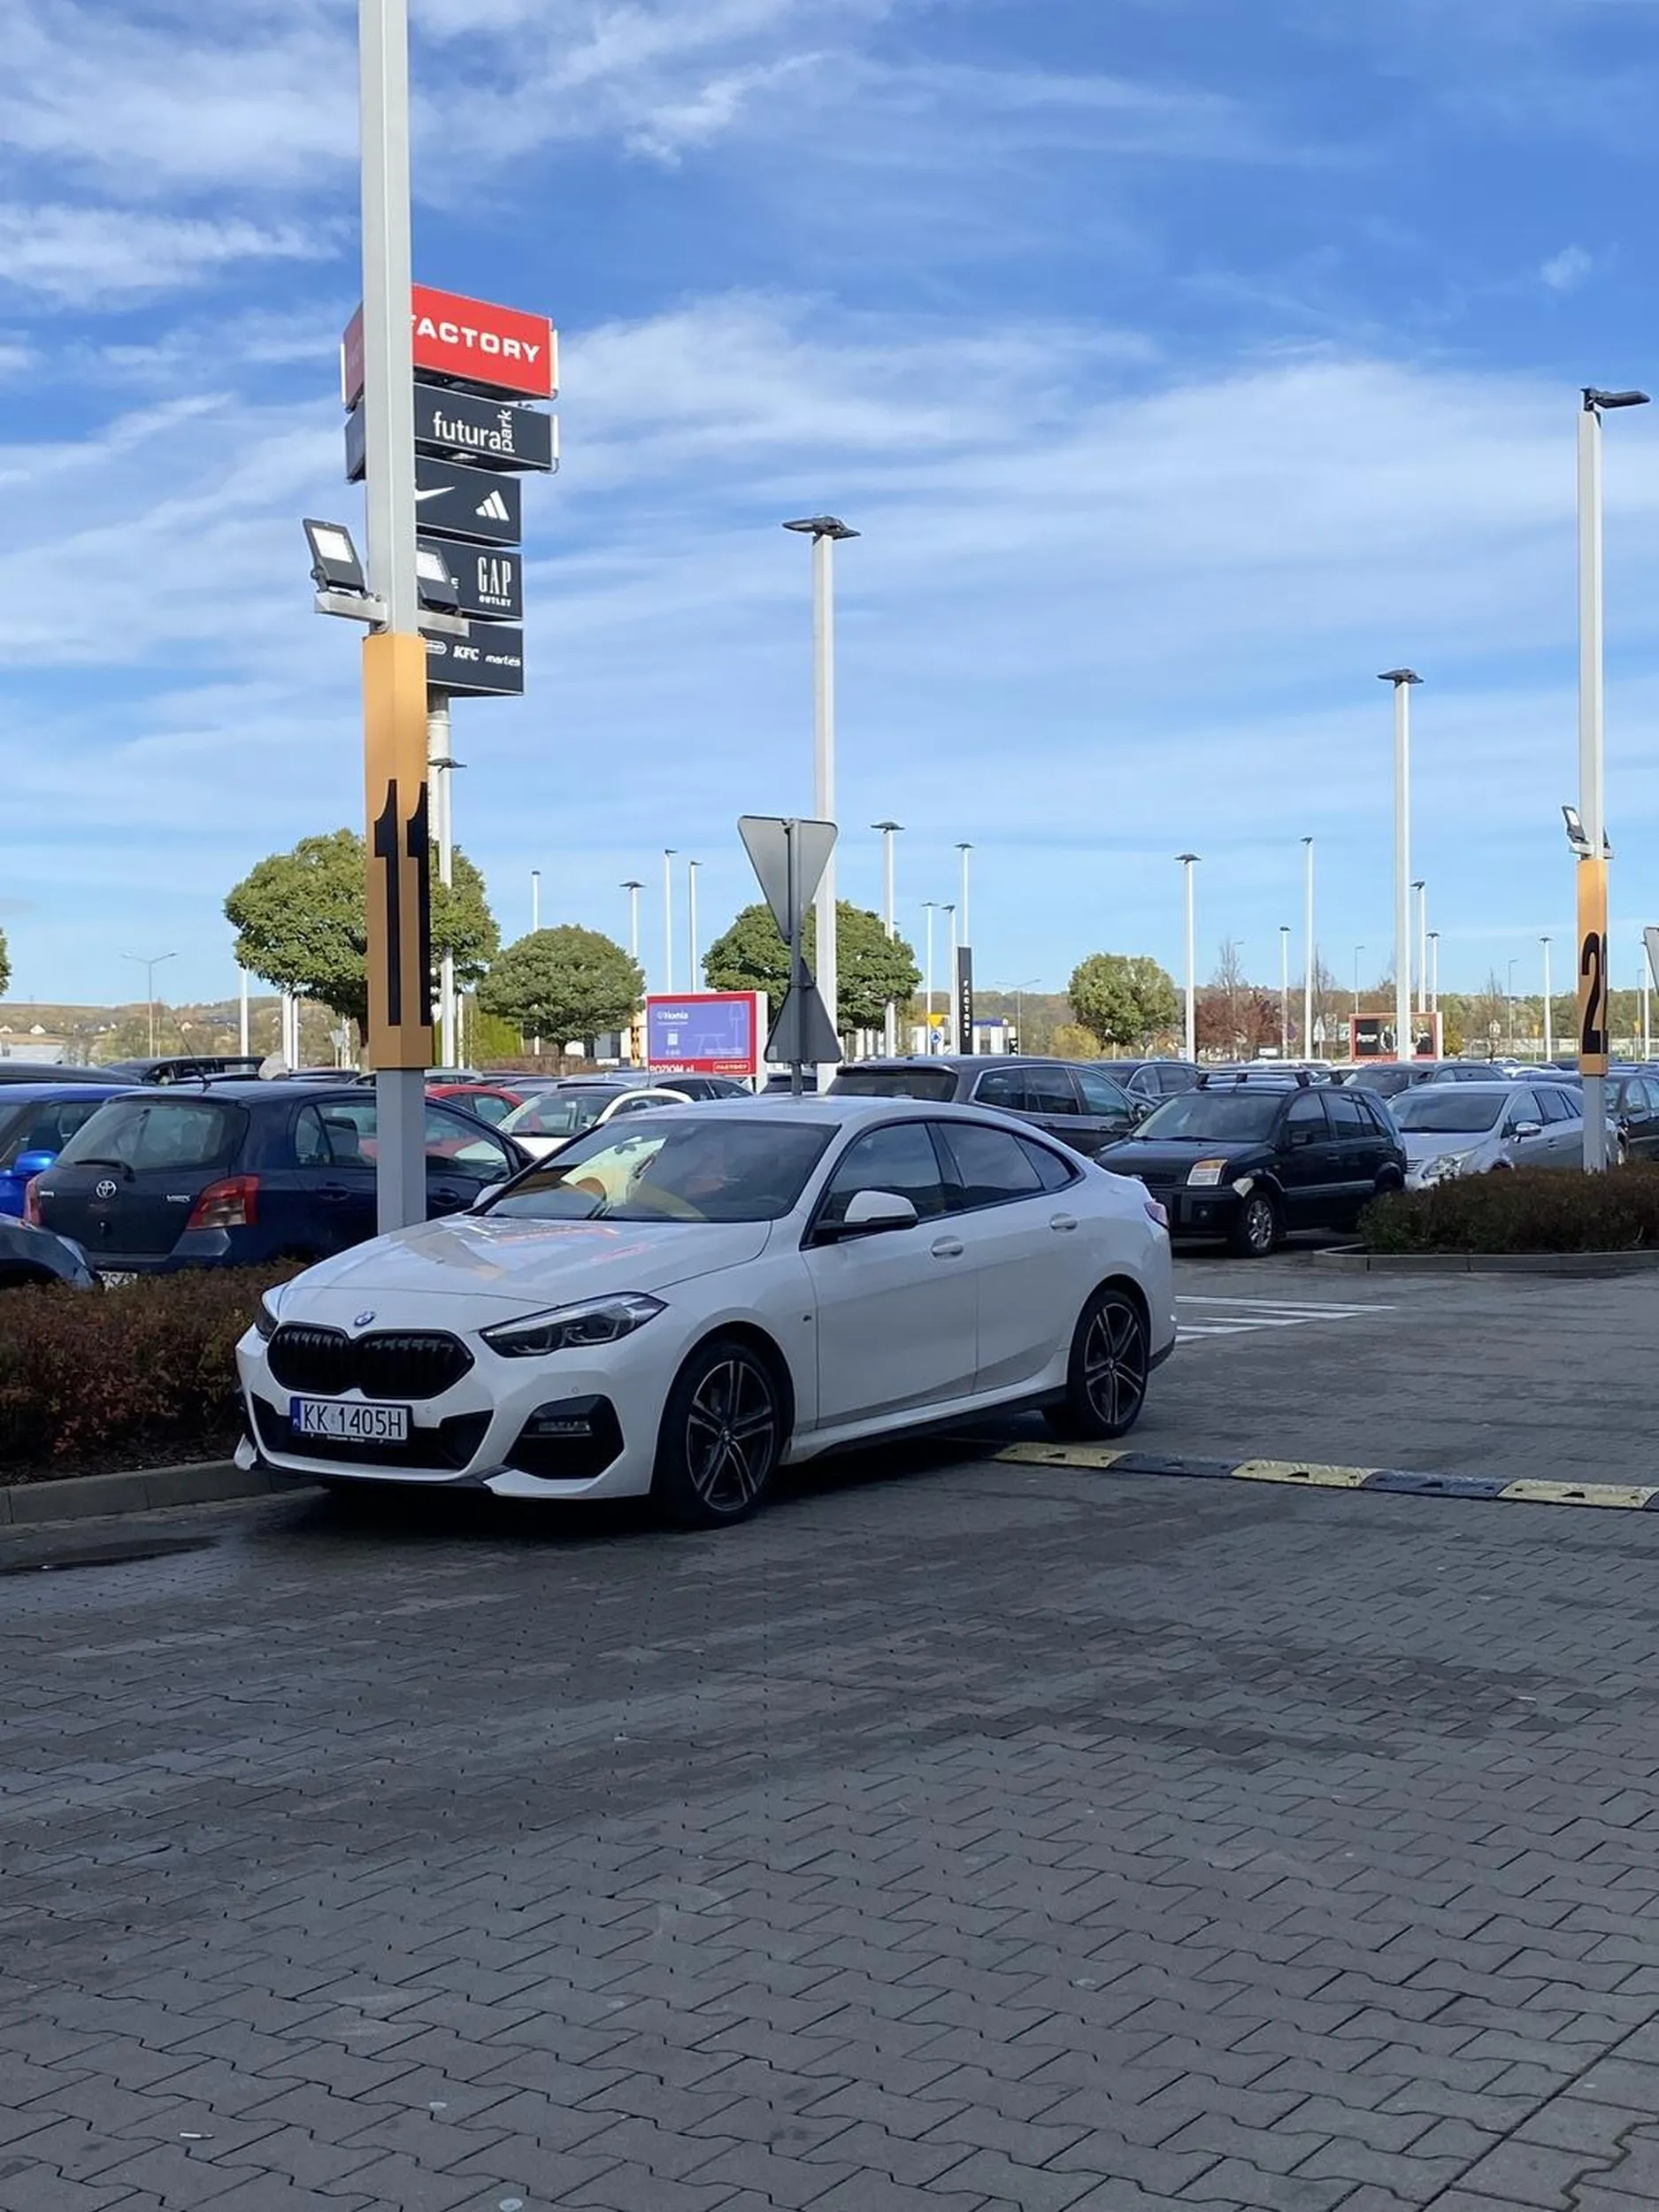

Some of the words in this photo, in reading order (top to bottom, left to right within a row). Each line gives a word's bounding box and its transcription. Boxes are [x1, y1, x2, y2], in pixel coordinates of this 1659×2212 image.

[433, 411, 502, 449] futura
[497, 410, 515, 453] park
[478, 557, 511, 596] GAP
[479, 596, 512, 607] OUTLET
[453, 645, 480, 660] KFC
[303, 1403, 328, 1431] KK
[338, 1407, 401, 1437] 1405H
